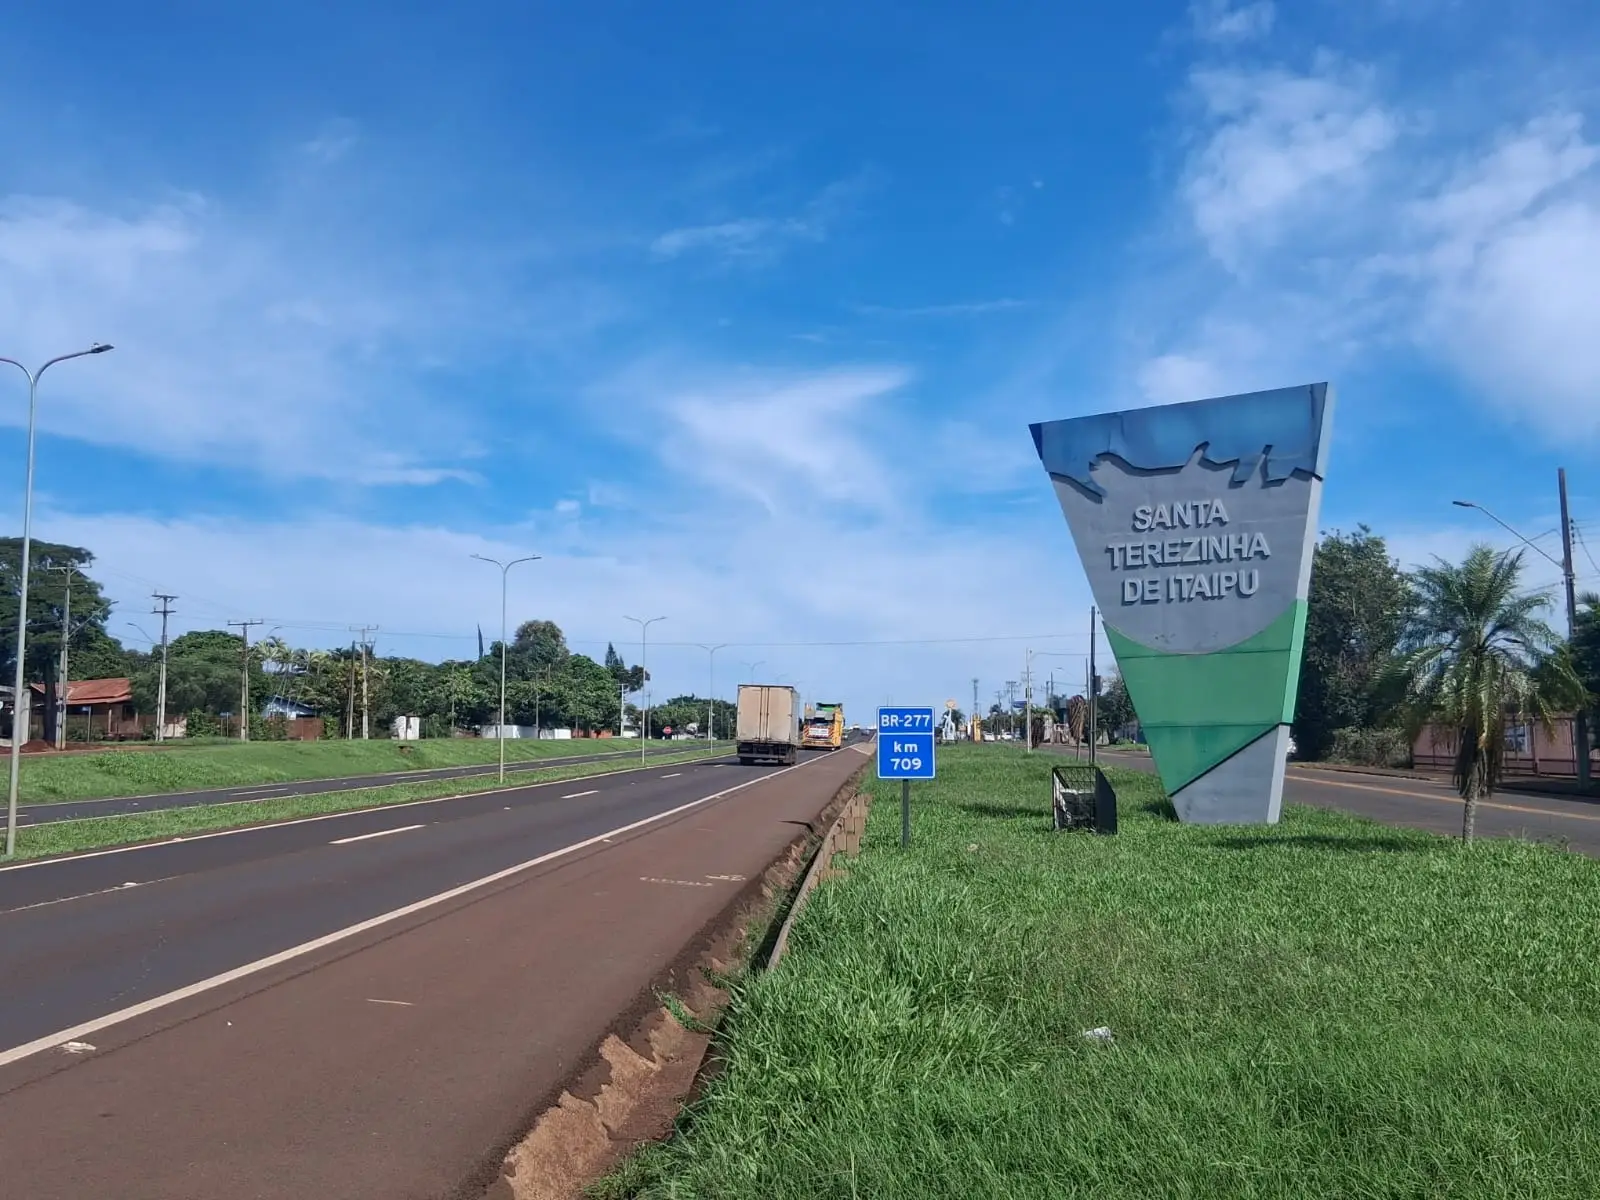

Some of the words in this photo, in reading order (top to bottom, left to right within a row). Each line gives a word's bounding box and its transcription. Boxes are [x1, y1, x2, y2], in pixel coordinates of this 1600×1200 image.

[1133, 499, 1229, 531] SANTA
[1106, 532, 1271, 569] TEREZINHA
[1122, 577, 1161, 606] DE
[1166, 568, 1260, 603] ITAIPU
[881, 714, 931, 727] BR-277
[893, 740, 918, 753] km
[890, 757, 922, 771] 709
